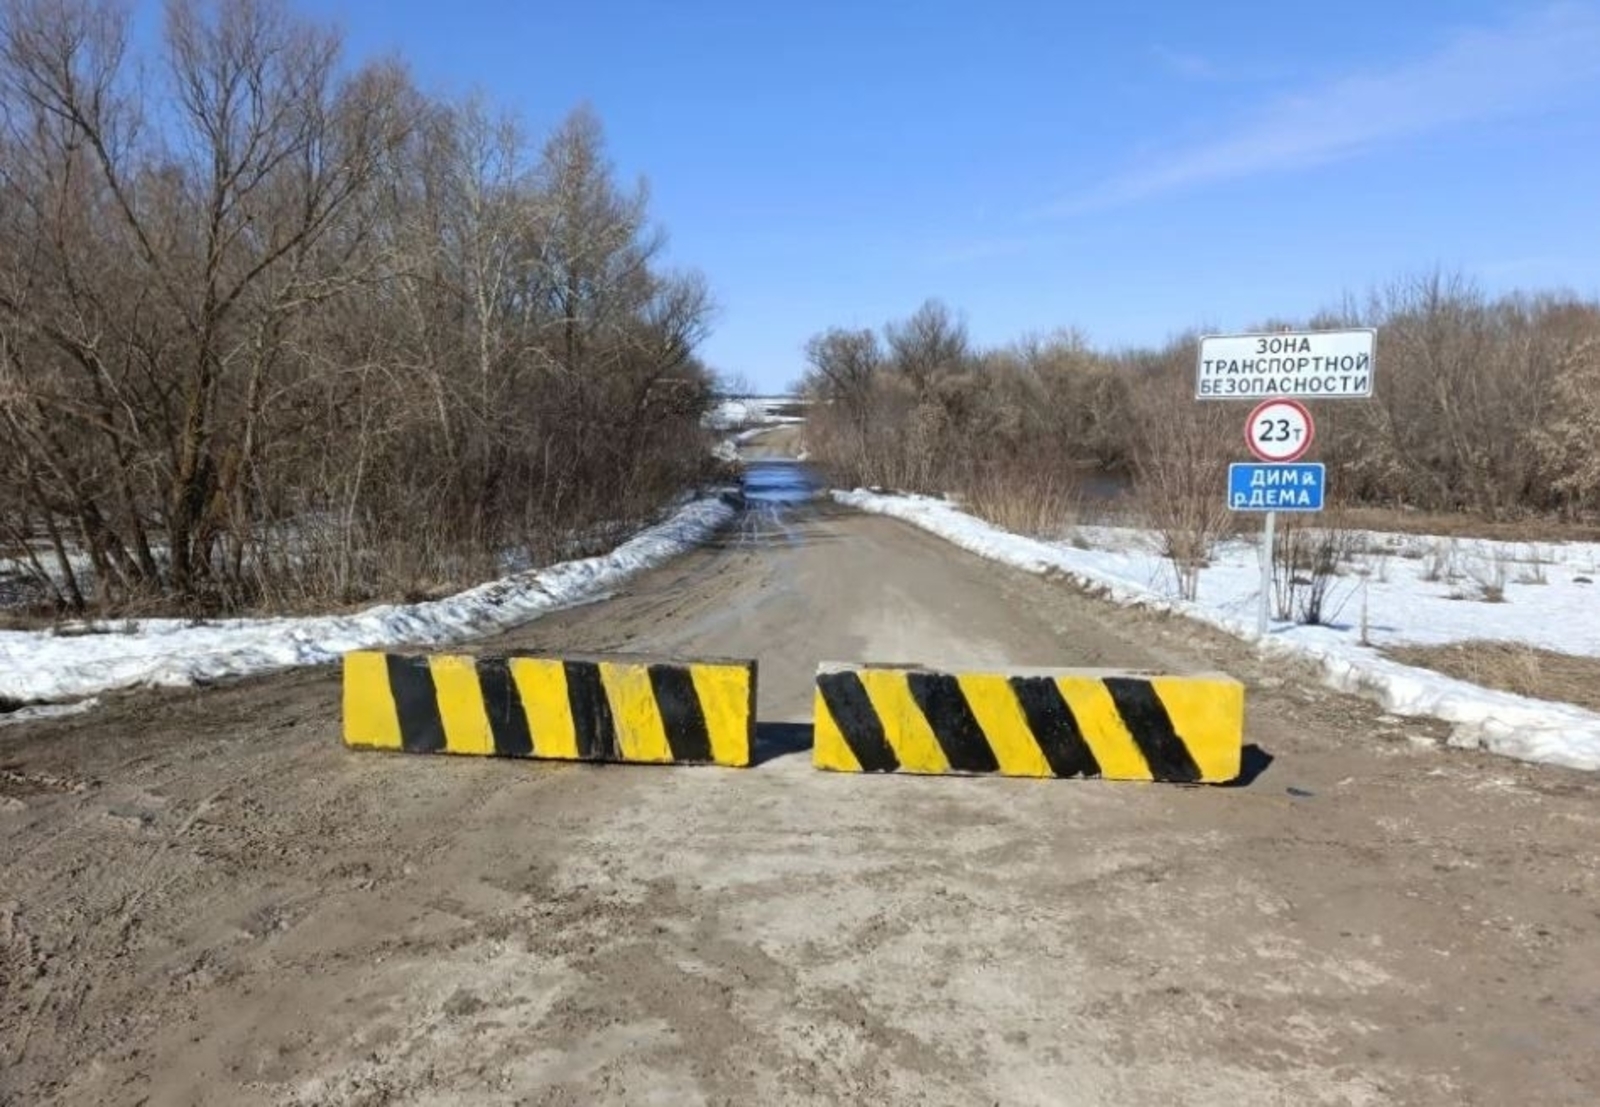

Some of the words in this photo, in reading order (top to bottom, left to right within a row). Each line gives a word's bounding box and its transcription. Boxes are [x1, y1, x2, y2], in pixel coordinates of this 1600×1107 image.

[1256, 338, 1311, 354] ЗОНА
[1203, 353, 1369, 375] ТРАНСПОРТНОЙ
[1201, 376, 1367, 394] БЕЗОПАСНОСТИ
[1250, 469, 1298, 488] ДИМ
